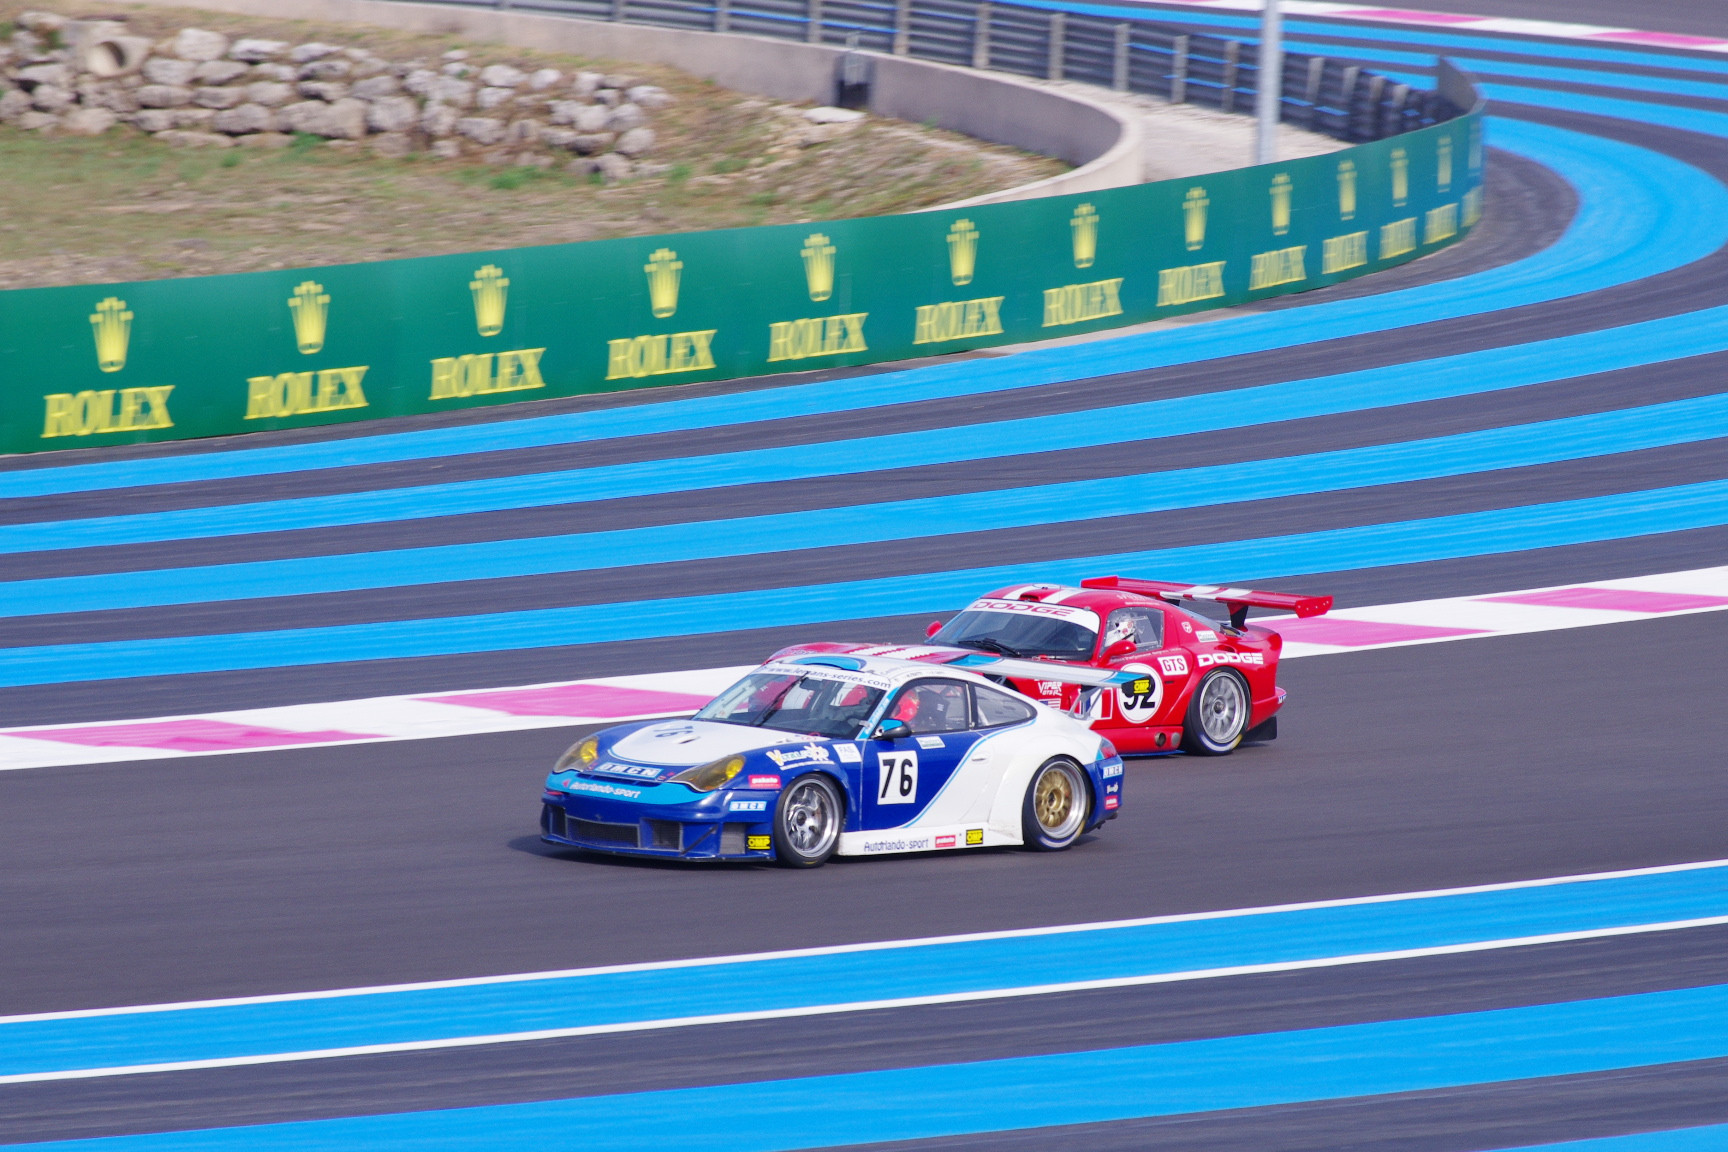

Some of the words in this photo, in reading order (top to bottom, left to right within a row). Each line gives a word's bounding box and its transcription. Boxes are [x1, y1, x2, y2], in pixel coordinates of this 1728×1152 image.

[768, 312, 868, 362] ROLEX
[914, 295, 1004, 345] ROLEX
[429, 347, 546, 401] ROLEX
[607, 329, 717, 381] ROLEX
[42, 385, 175, 439] ROLEX
[244, 365, 369, 420] ROLEX
[972, 601, 1075, 617] DODGE
[1162, 655, 1186, 673] GTS
[1196, 651, 1264, 667] DODGE
[881, 757, 913, 799] 76
[748, 837, 771, 848] OMP
